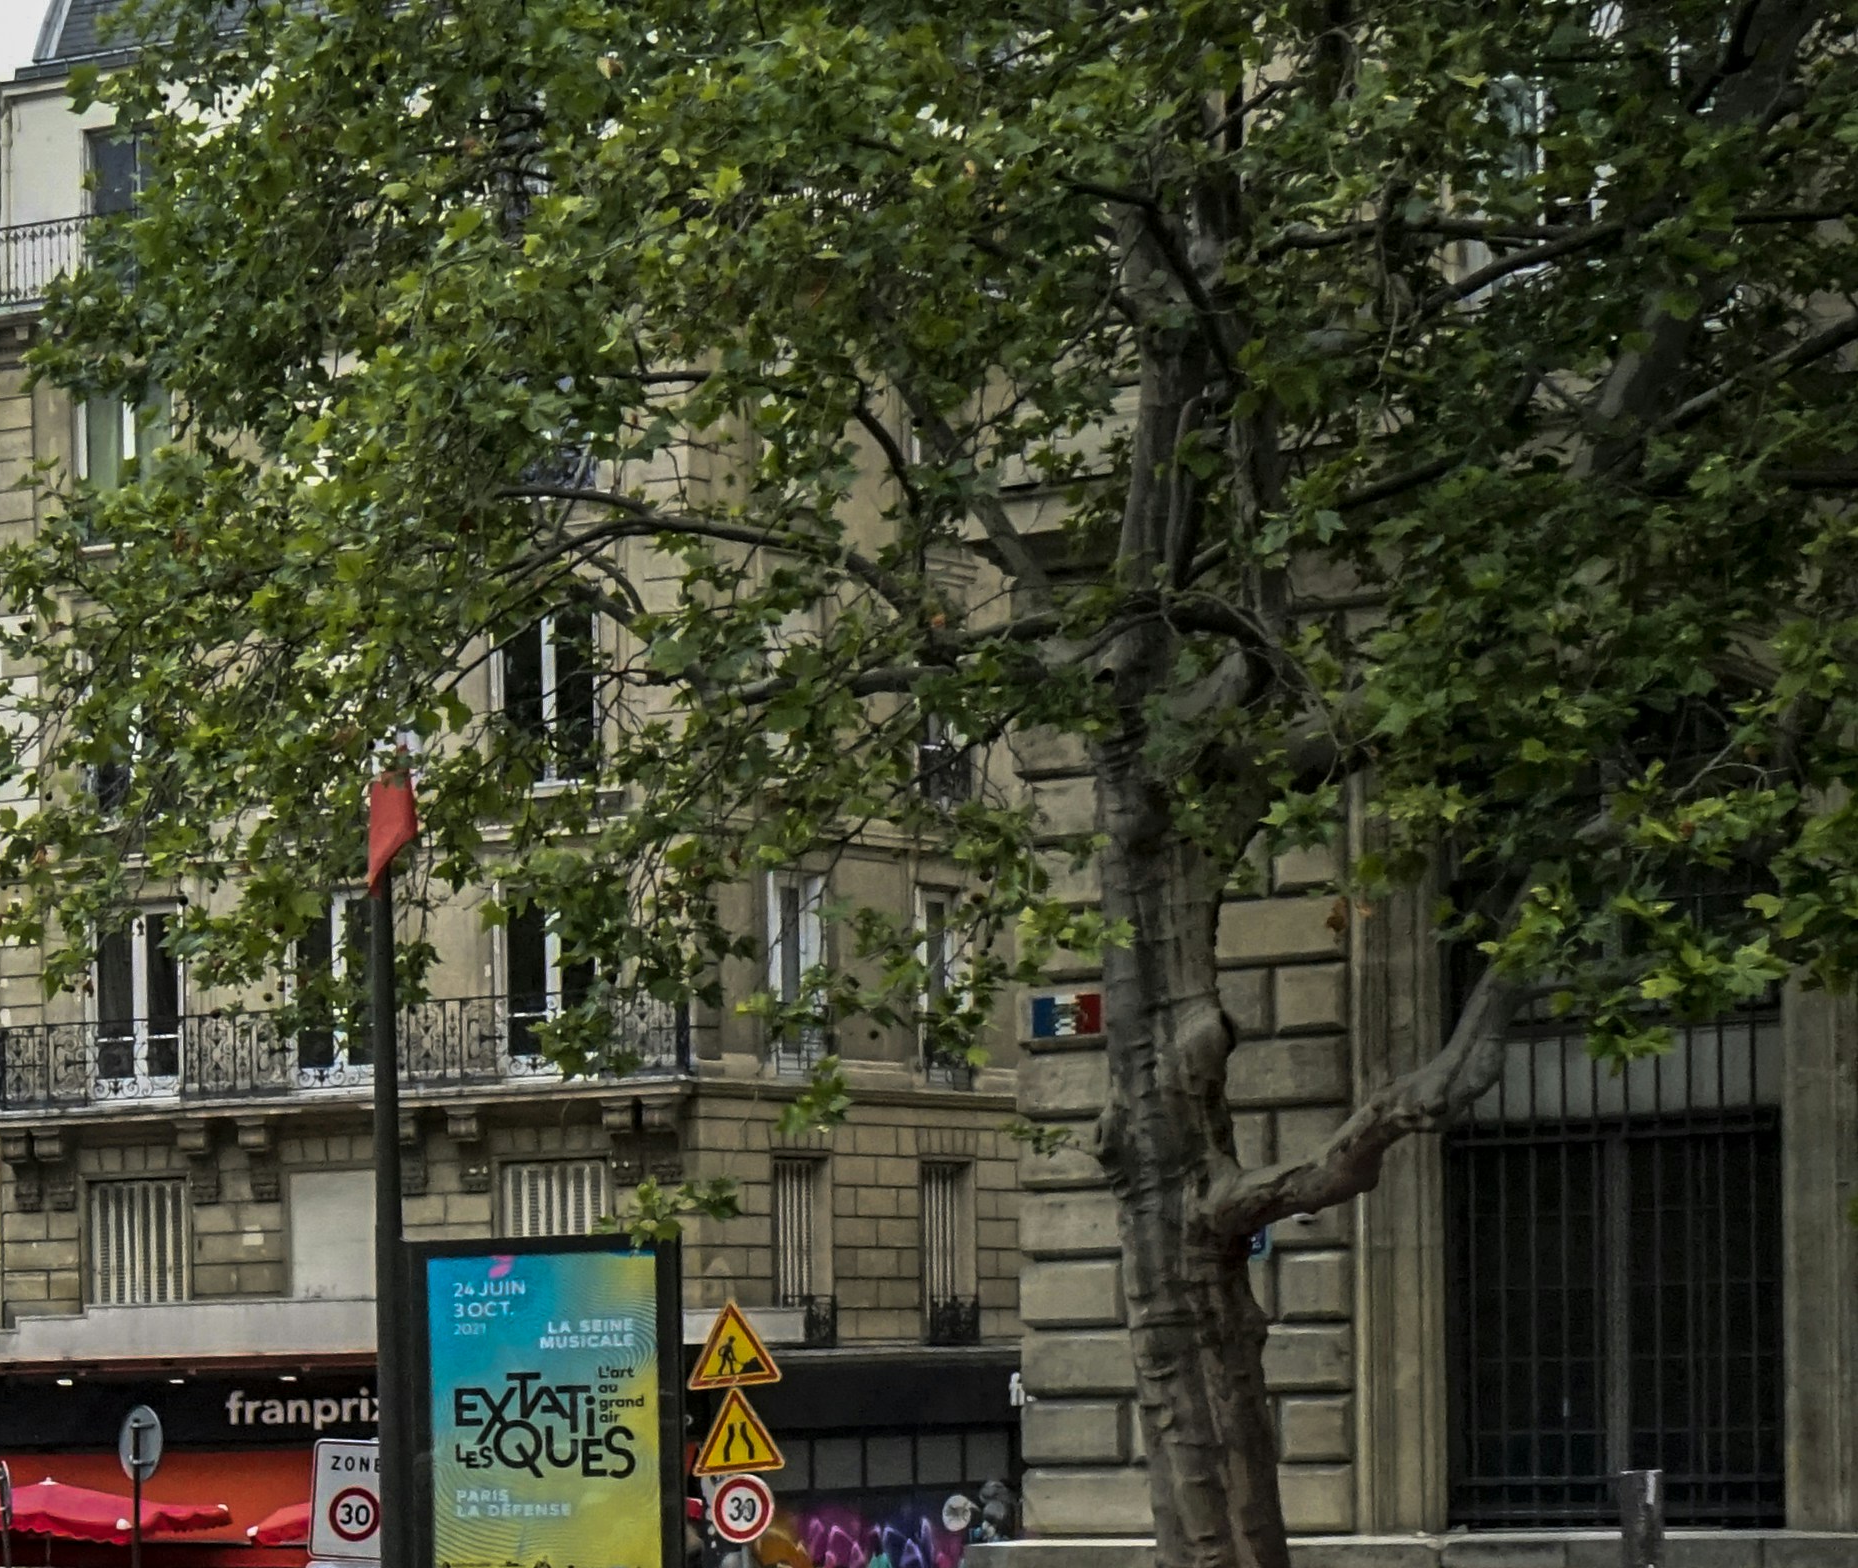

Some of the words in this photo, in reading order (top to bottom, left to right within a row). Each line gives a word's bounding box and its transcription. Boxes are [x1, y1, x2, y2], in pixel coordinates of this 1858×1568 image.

[453, 1282, 475, 1298] 24
[478, 1280, 526, 1297] JUIN
[453, 1303, 465, 1318] 3
[467, 1301, 515, 1317] OCT.
[453, 1323, 487, 1335] 2021
[547, 1320, 572, 1335] LA
[579, 1318, 634, 1333] SEINE
[539, 1334, 635, 1349] MUSICALE
[597, 1366, 635, 1379] L'art
[597, 1383, 619, 1394] au
[598, 1395, 645, 1411] grand
[598, 1411, 621, 1424] air
[330, 1456, 381, 1473] ZONE
[455, 1444, 494, 1469] LES
[456, 1489, 509, 1502] PARIS
[340, 1503, 370, 1526] 30
[456, 1504, 480, 1518] LA
[729, 1496, 756, 1522] 30
